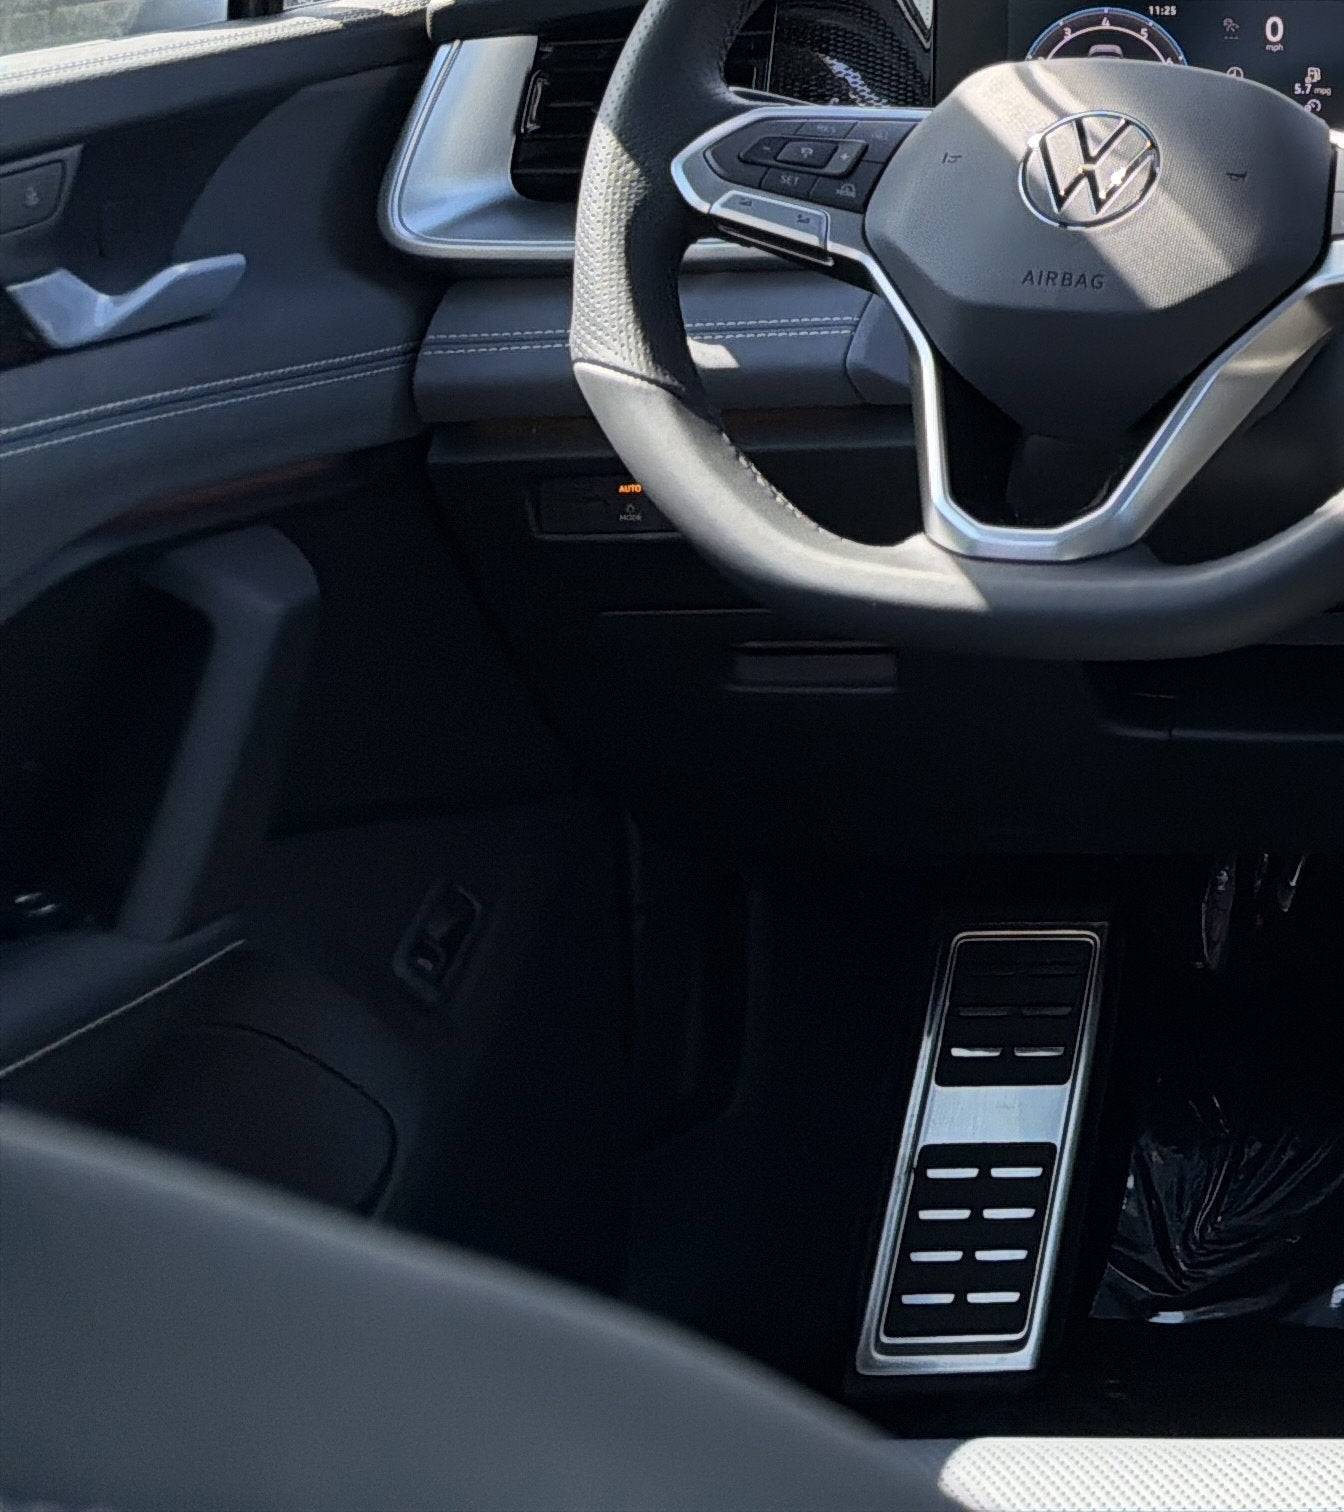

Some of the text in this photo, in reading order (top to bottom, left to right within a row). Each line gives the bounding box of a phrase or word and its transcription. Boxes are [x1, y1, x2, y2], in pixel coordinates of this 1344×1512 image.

[1149, 6, 1177, 15] 11:25
[1102, 18, 1110, 27] 4
[1063, 28, 1072, 38] 3
[1141, 29, 1148, 38] 5
[1265, 16, 1283, 43] 0
[1266, 44, 1284, 52] mph
[1294, 84, 1332, 96] 5.7 mpg
[781, 175, 800, 187] SET
[1022, 270, 1105, 289] AIRBAG
[619, 484, 642, 493] AUTO
